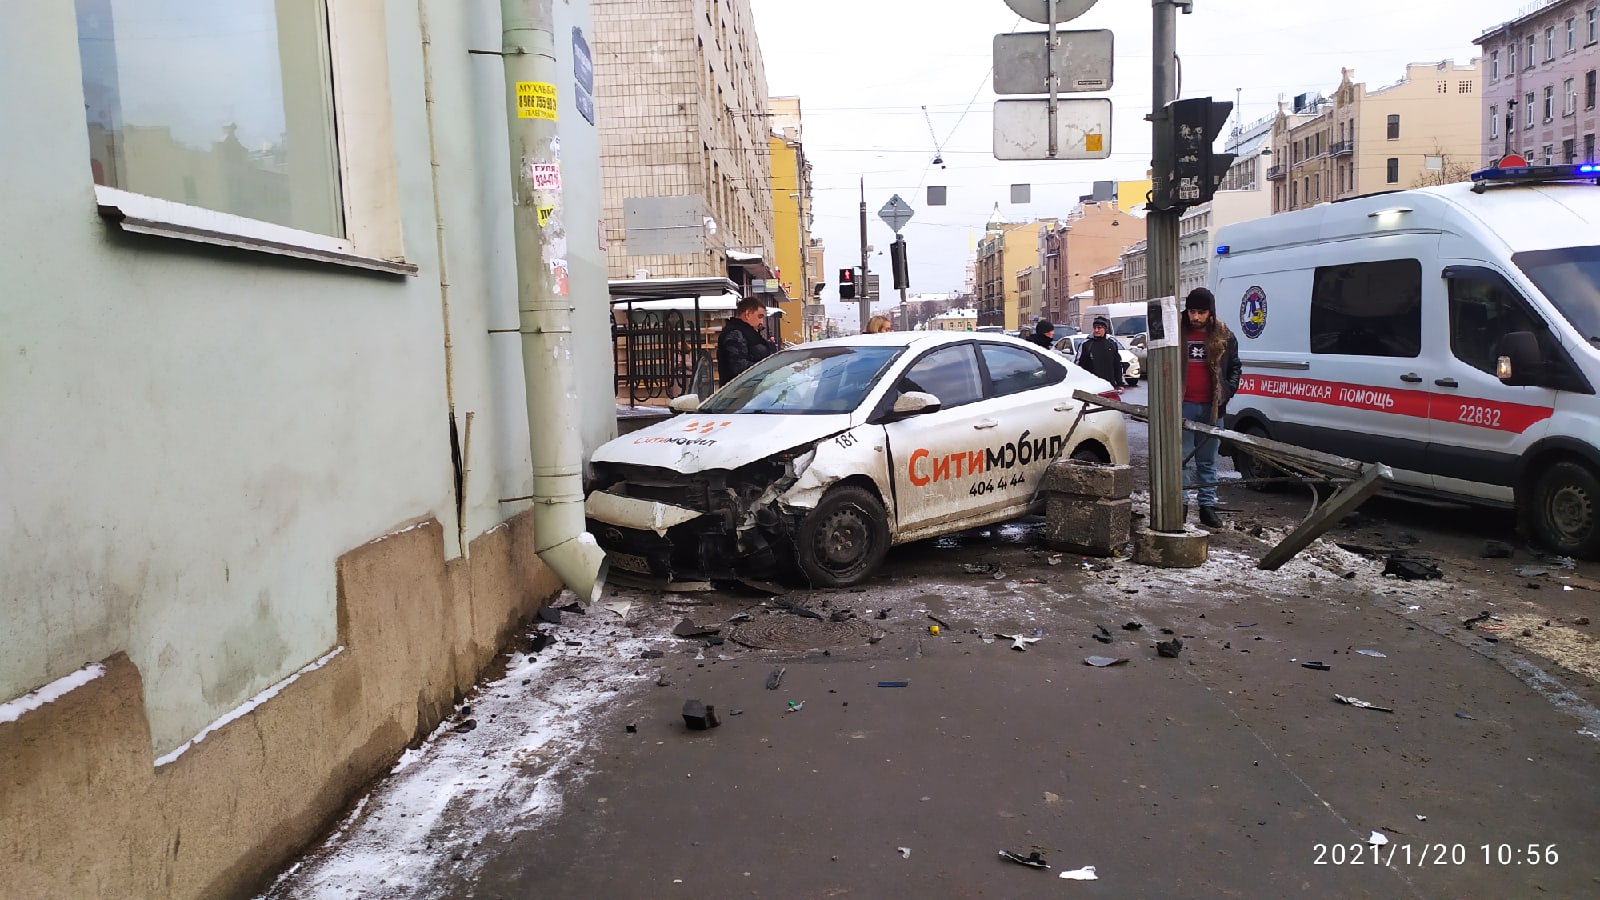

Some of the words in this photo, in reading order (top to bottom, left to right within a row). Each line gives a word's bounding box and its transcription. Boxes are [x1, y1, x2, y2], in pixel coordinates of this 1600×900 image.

[1238, 378, 1255, 391] РАЯ
[1260, 379, 1332, 400] МЕДИЦИНСКАЯ
[1339, 387, 1395, 410] ПОМОЩЬ
[1458, 404, 1501, 427] 22832
[835, 431, 858, 449] 181
[969, 478, 995, 497] 404
[1010, 471, 1026, 487] 44
